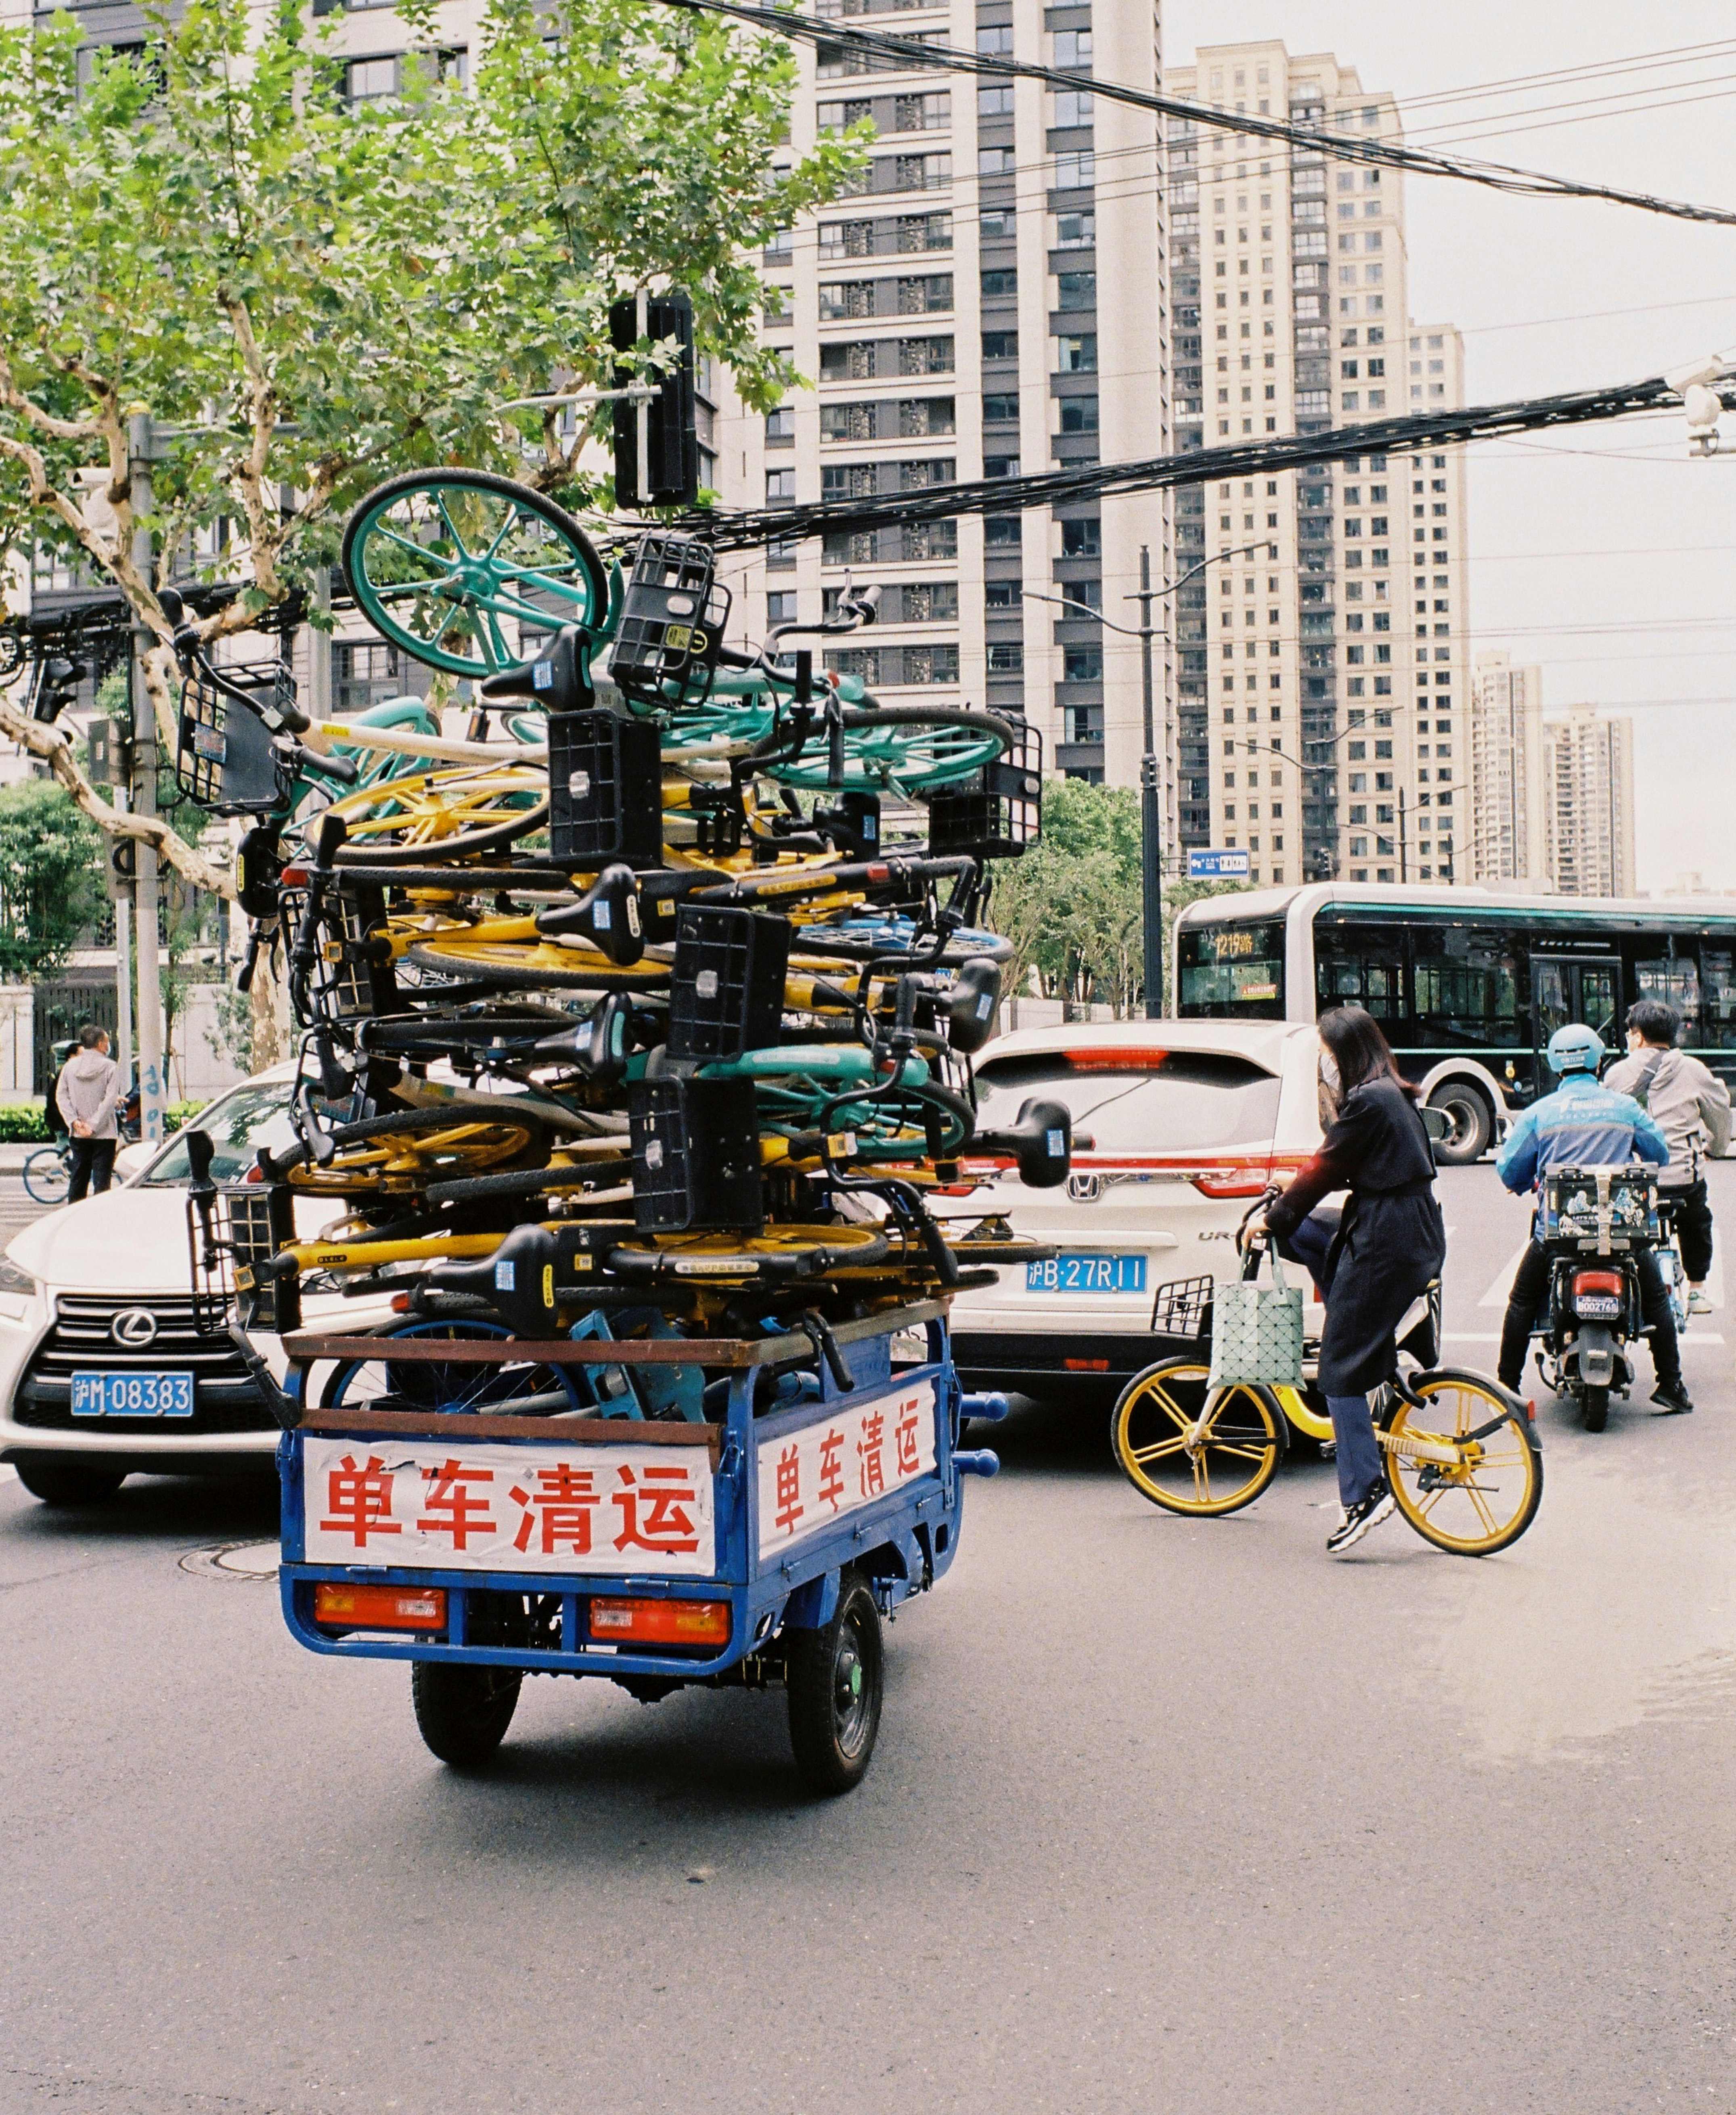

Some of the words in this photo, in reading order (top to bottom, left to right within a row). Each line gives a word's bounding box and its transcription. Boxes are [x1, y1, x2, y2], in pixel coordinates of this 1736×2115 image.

[75, 1379, 189, 1409] 沪M·08383
[320, 1455, 699, 1555] 单车清运
[775, 1398, 919, 1535] 单车清运
